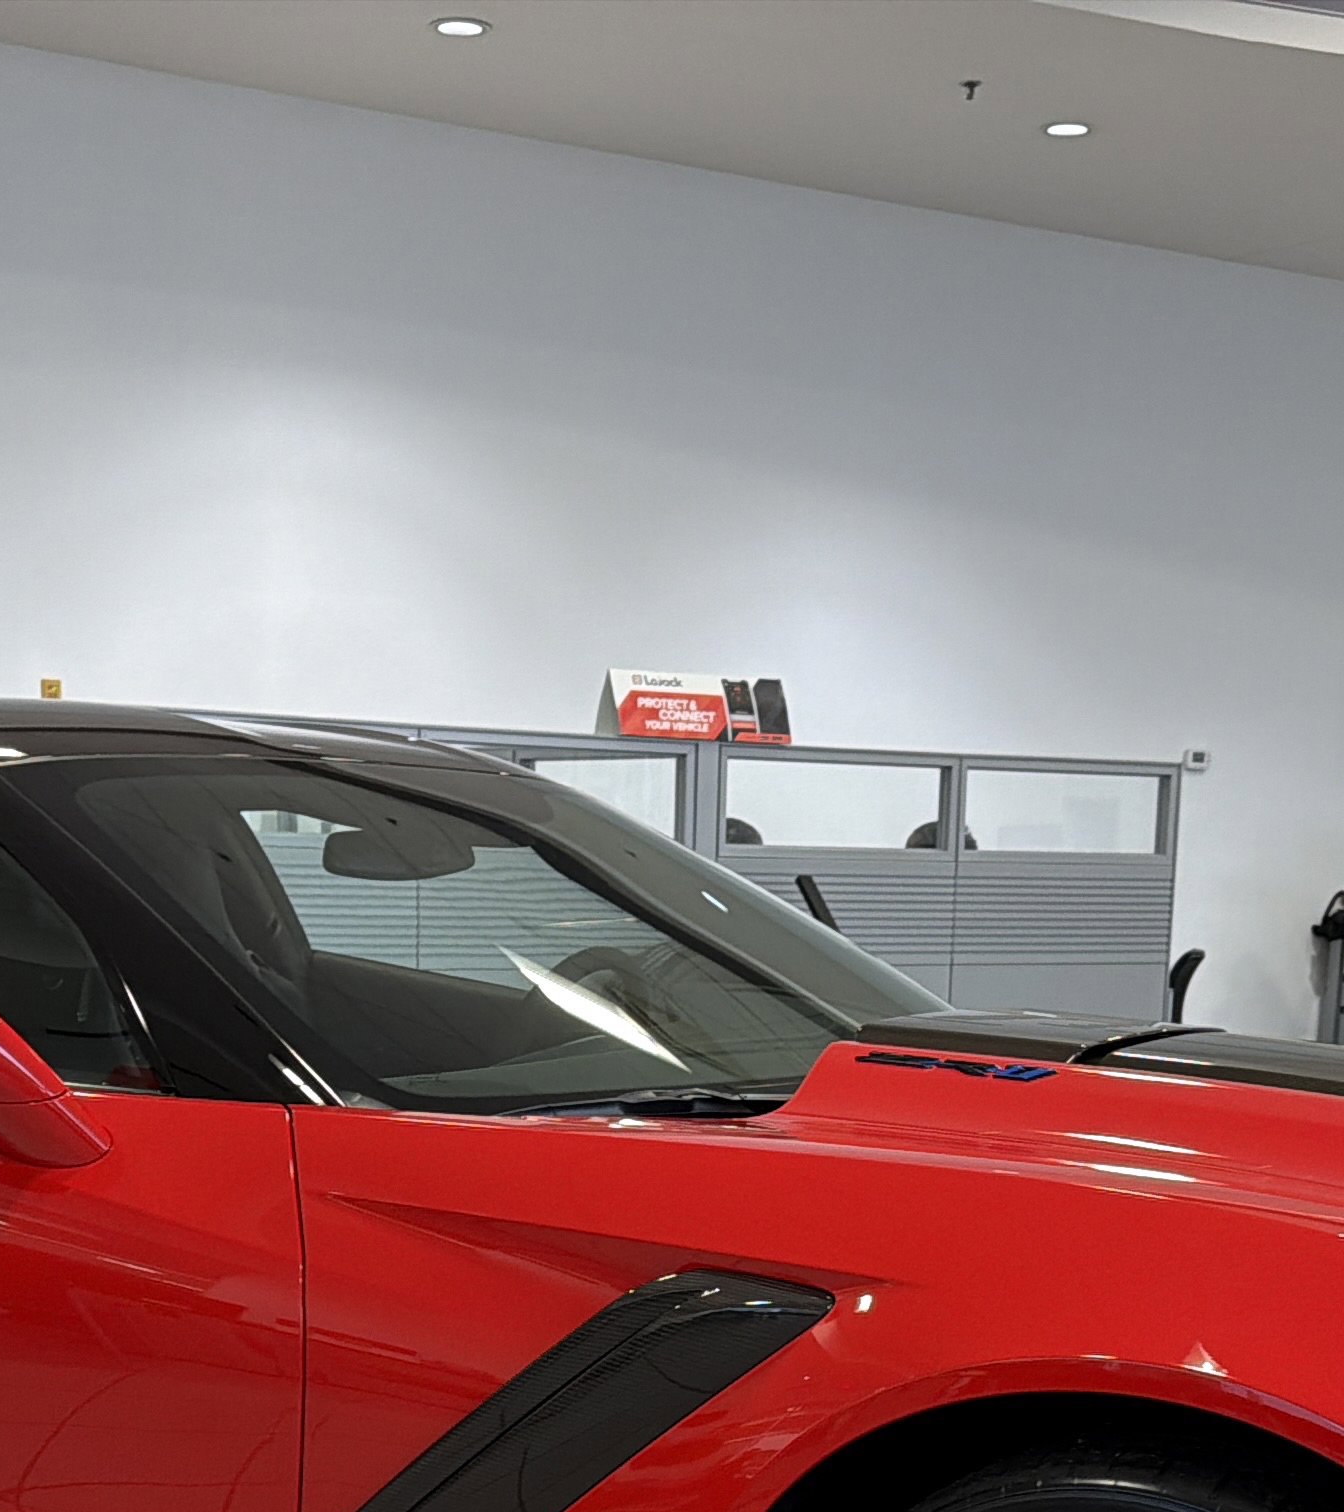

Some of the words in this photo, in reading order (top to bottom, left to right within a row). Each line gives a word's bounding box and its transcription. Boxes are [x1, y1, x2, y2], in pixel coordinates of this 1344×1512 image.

[637, 697, 688, 710] PROTECT
[689, 700, 697, 710] &
[658, 709, 716, 723] CONNECT
[645, 720, 671, 731] YOUR
[672, 721, 710, 733] VEHICLE
